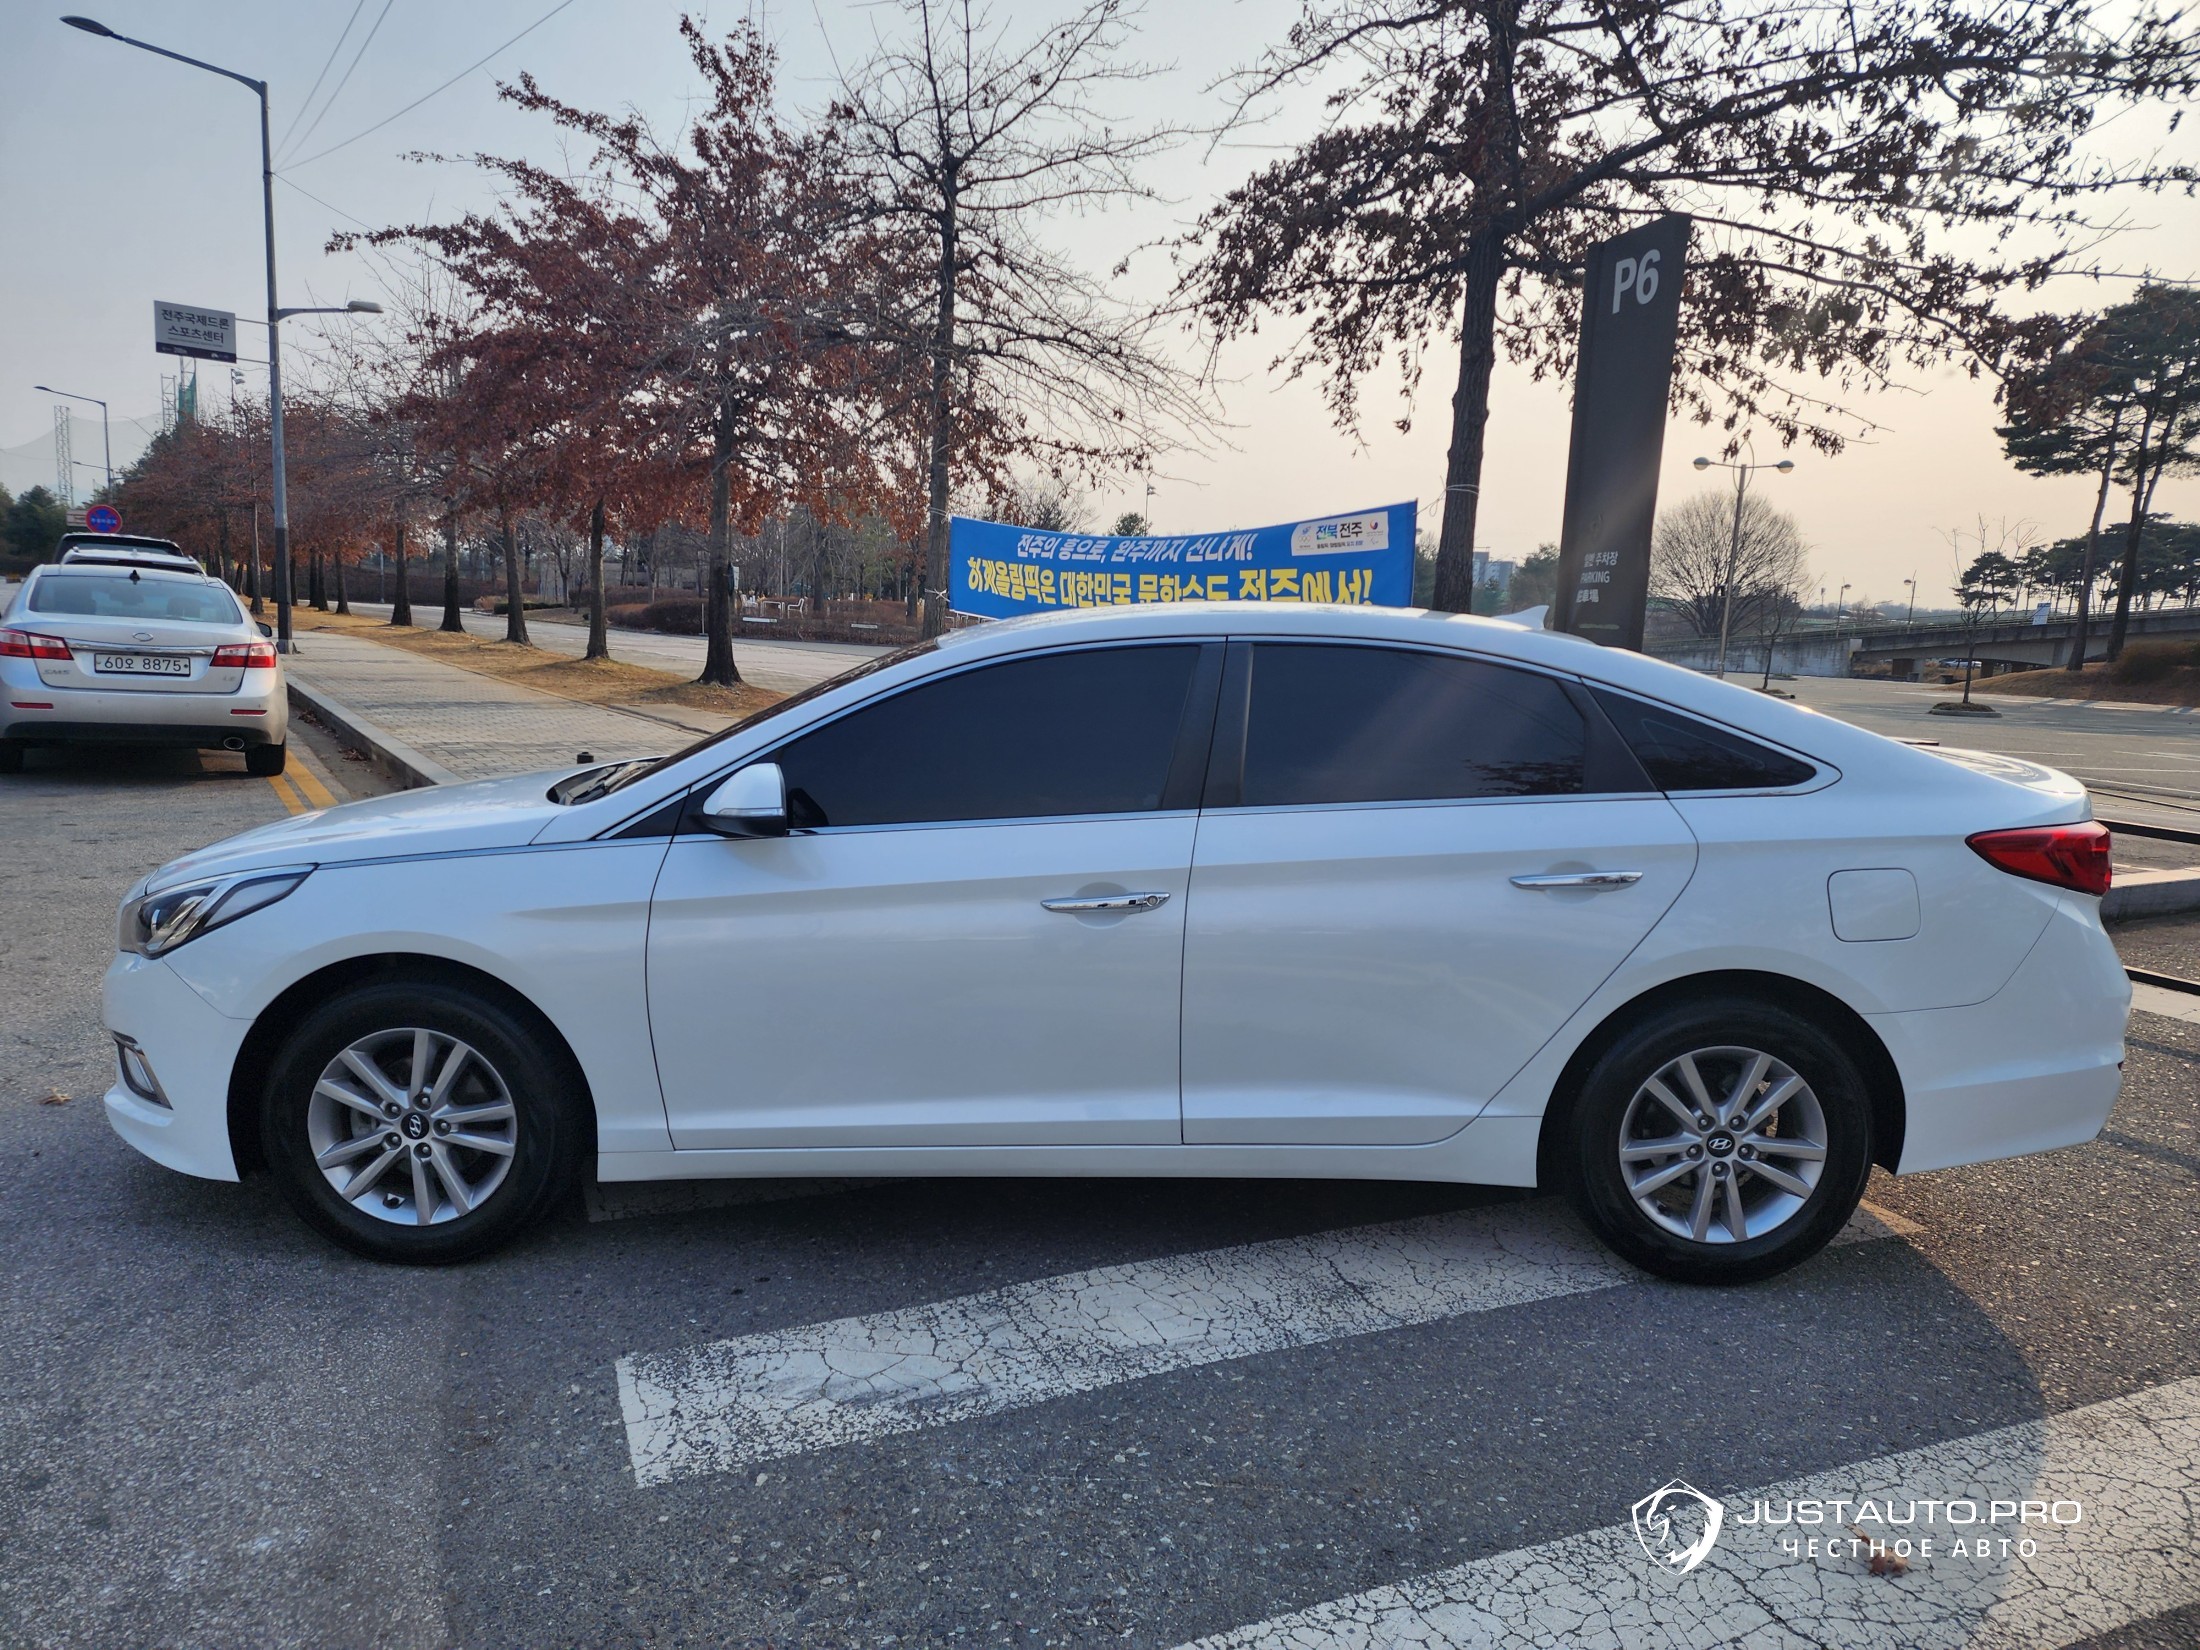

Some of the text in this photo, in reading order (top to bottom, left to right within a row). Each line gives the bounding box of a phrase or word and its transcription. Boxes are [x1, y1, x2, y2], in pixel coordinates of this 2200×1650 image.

[1612, 248, 1661, 315] P6
[167, 325, 224, 344] 스포츠센터
[1315, 521, 1363, 541] 전북 전주
[1017, 532, 1259, 564] 전주의 흥으로, 완주까지 신나게!
[1596, 550, 1619, 567] 주차장
[967, 556, 1057, 605] 하계올림픽은
[1059, 571, 1132, 608] 대한민국
[1580, 570, 1611, 584] PARKING
[104, 656, 182, 672] 60오 8875
